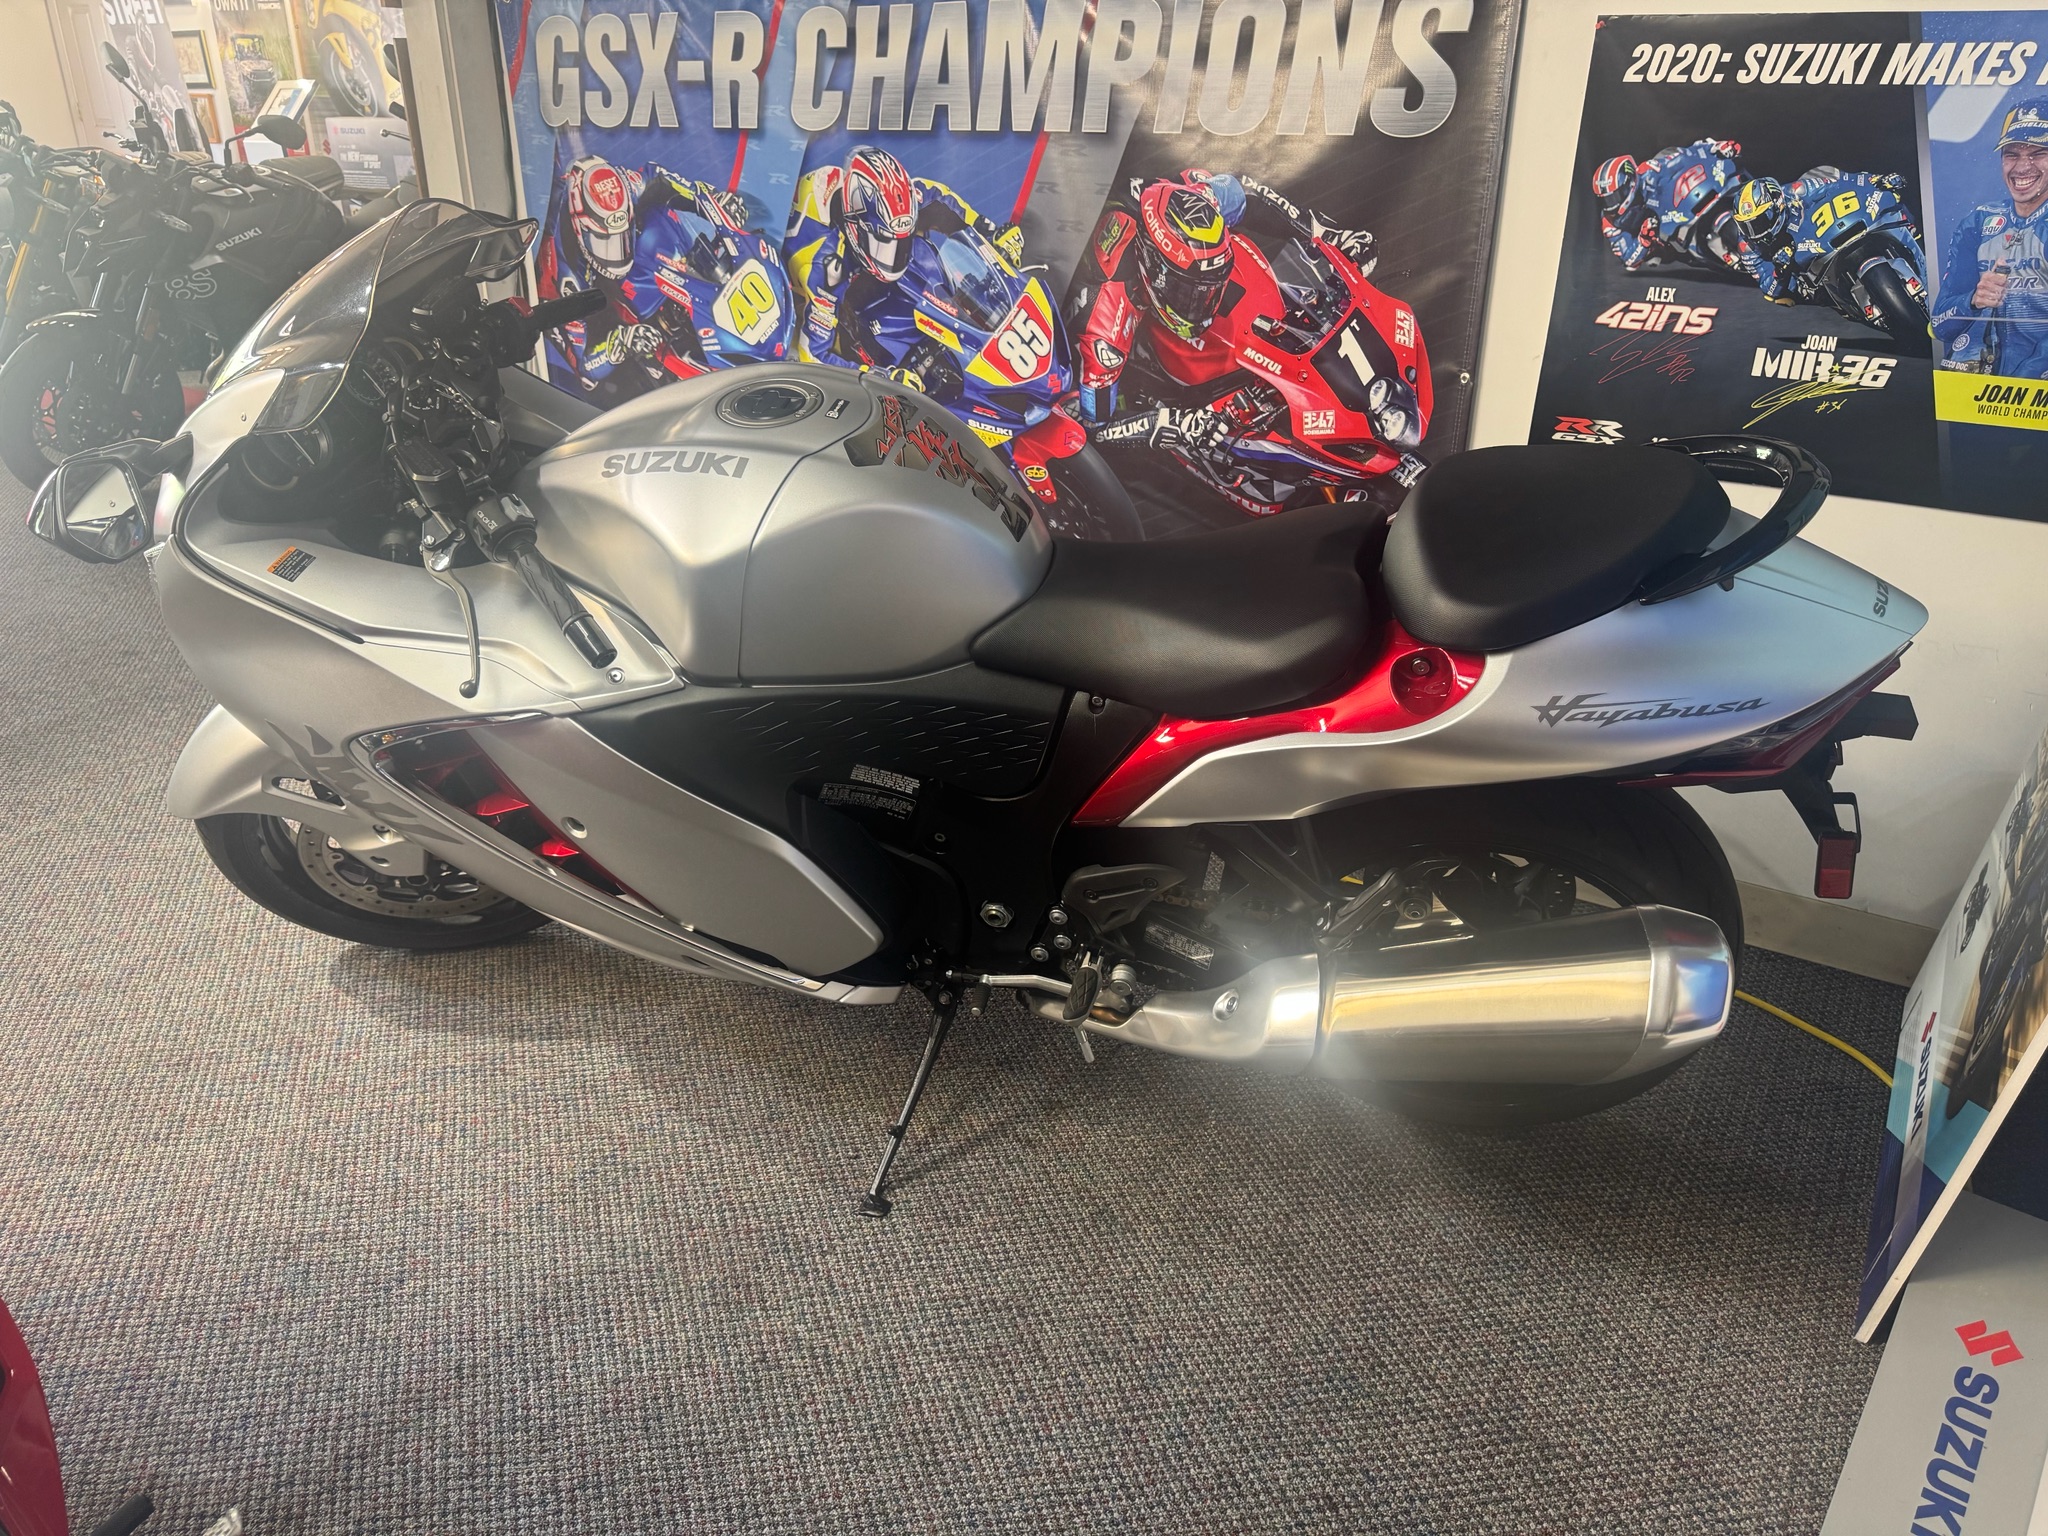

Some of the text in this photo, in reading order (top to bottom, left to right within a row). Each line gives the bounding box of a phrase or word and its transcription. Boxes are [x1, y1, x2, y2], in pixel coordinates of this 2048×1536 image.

[536, 11, 765, 129] GSX-R
[791, 0, 1475, 138] CHAMPIONS
[1622, 43, 1733, 84] 2020:
[1736, 43, 1884, 85] SUZUKI
[1879, 41, 2038, 85] MAKES
[594, 176, 619, 193] RESET
[1241, 174, 1301, 220] SUZUKI
[1143, 198, 1173, 254] Voltéo
[1811, 190, 1862, 239] 36
[215, 227, 263, 252] SUZUKI
[727, 271, 775, 336] 40
[1646, 286, 1677, 303] ALEX
[998, 307, 1051, 379] 85
[1337, 326, 1376, 387] 1
[1801, 334, 1838, 352] JOAN
[1243, 346, 1283, 376] MOTUL
[1974, 383, 2029, 406] JOAN
[1977, 403, 2011, 418] WORLD
[967, 418, 1013, 437] SUZUKI
[1095, 417, 1150, 443] SUZUKI
[601, 450, 750, 479] SUZUKI
[1026, 466, 1047, 479] sbs
[1530, 692, 1771, 729] Hayabusa
[1909, 1035, 1933, 1144] SUZUKI
